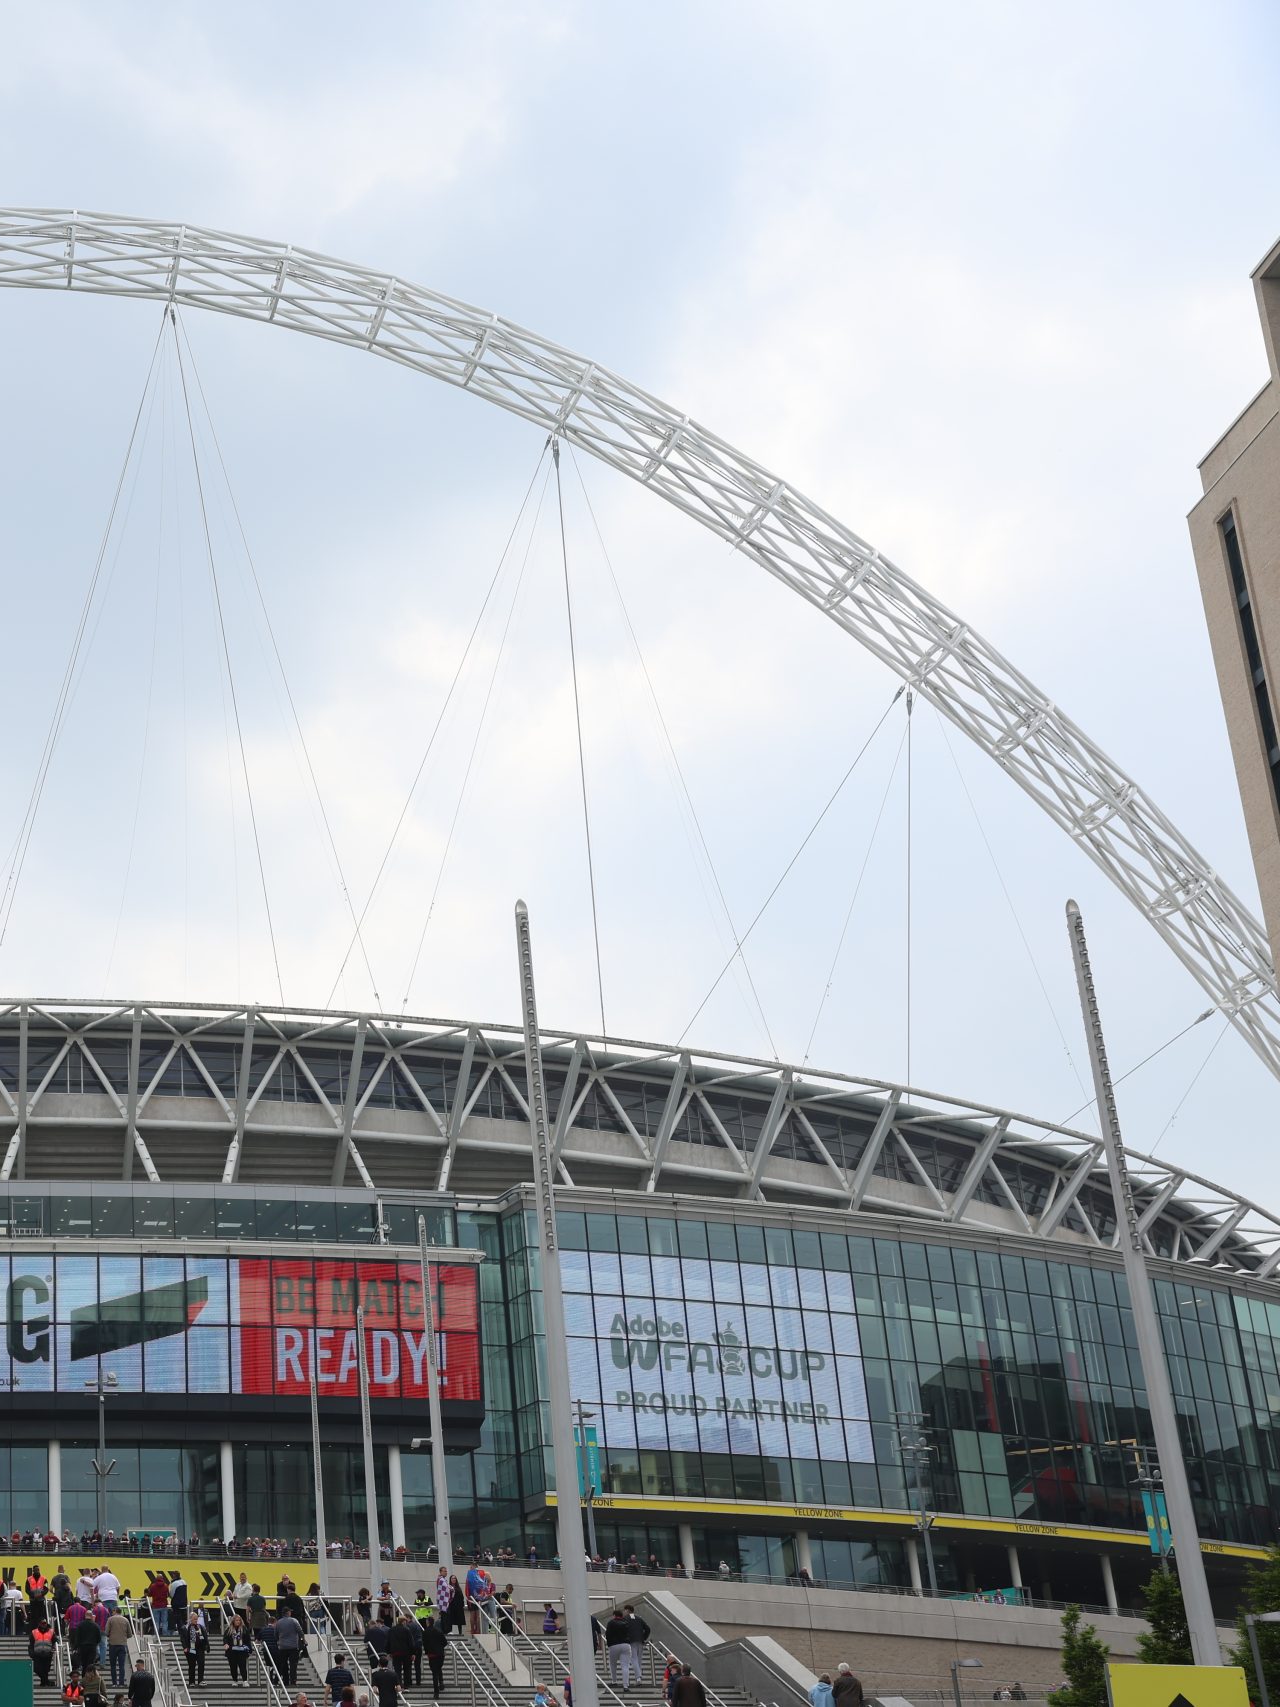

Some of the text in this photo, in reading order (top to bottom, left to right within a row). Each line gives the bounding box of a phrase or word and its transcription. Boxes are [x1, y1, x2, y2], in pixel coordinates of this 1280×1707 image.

[274, 1276, 316, 1314] BE
[610, 1313, 684, 1338] Adobe
[276, 1327, 448, 1386] READY!
[610, 1336, 826, 1381] WFA CUP
[616, 1390, 830, 1426] PROUD PARTNER
[592, 1499, 615, 1507] ZONE
[793, 1507, 844, 1518] YELLOW ZONE
[1014, 1523, 1059, 1535] YELLOW ZONE
